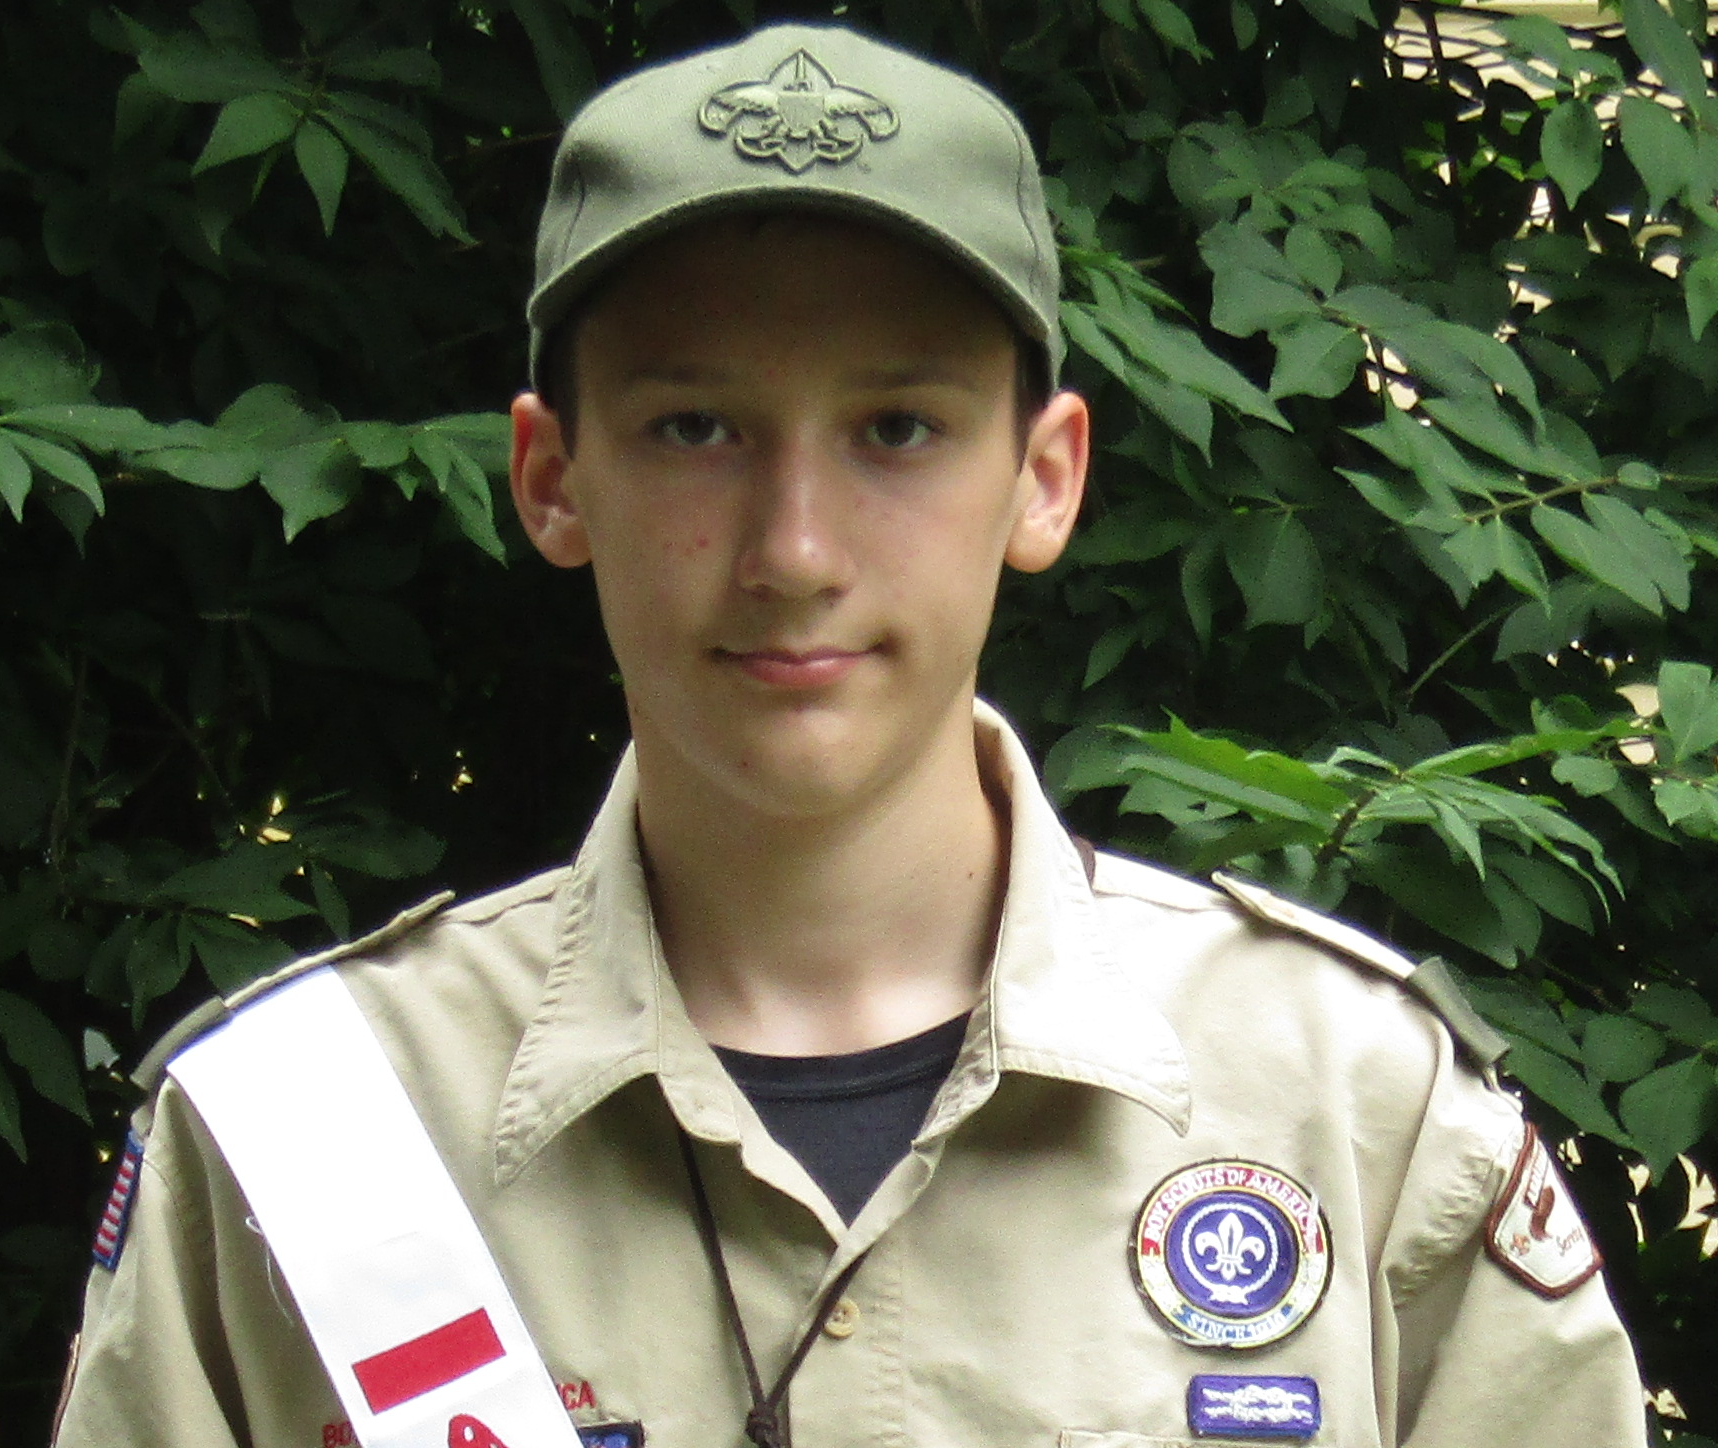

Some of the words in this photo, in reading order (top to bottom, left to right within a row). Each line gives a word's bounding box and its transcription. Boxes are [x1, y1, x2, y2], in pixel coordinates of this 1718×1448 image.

[1144, 1199, 1170, 1242] BOY
[1162, 1168, 1225, 1208] SCOUTS
[1187, 1313, 1246, 1339] SINCE
